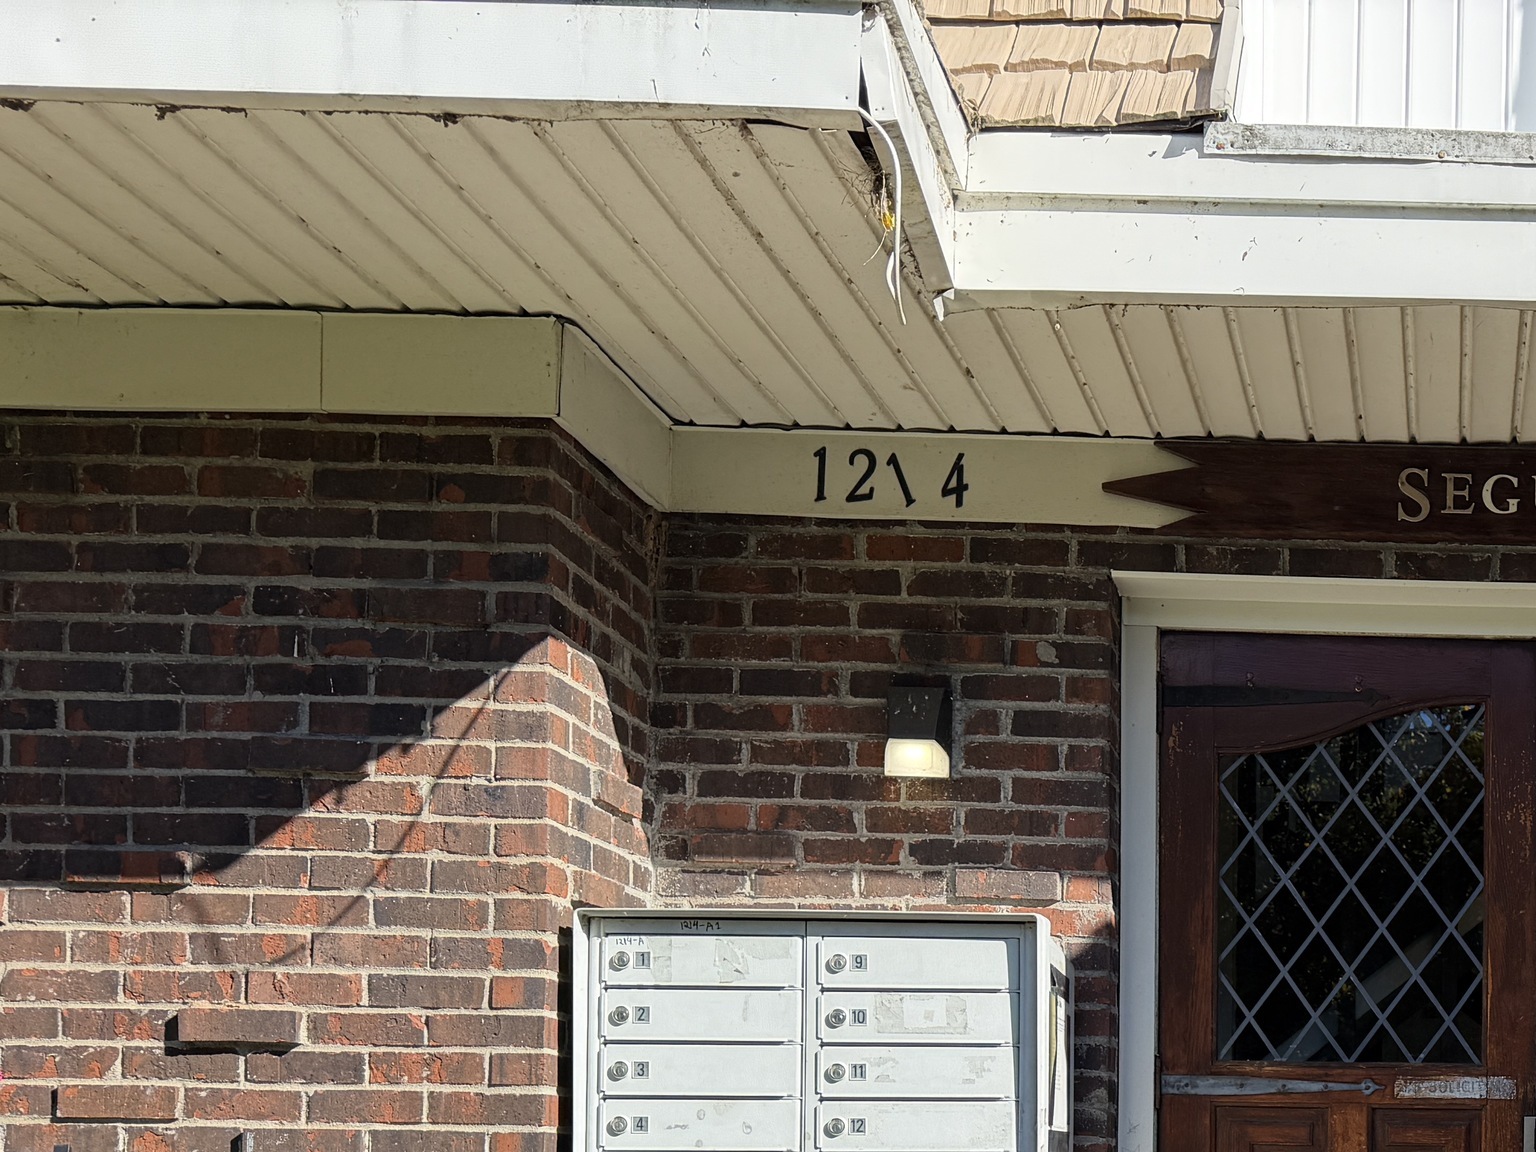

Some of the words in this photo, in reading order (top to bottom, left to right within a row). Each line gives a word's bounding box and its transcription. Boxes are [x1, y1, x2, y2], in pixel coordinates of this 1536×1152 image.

[855, 955, 863, 969] 9
[637, 1008, 645, 1022] 2
[851, 1010, 865, 1024] 10
[637, 1063, 645, 1077] 3
[852, 1065, 864, 1079] 11
[636, 1117, 645, 1131] 4
[850, 1120, 864, 1133] 12
